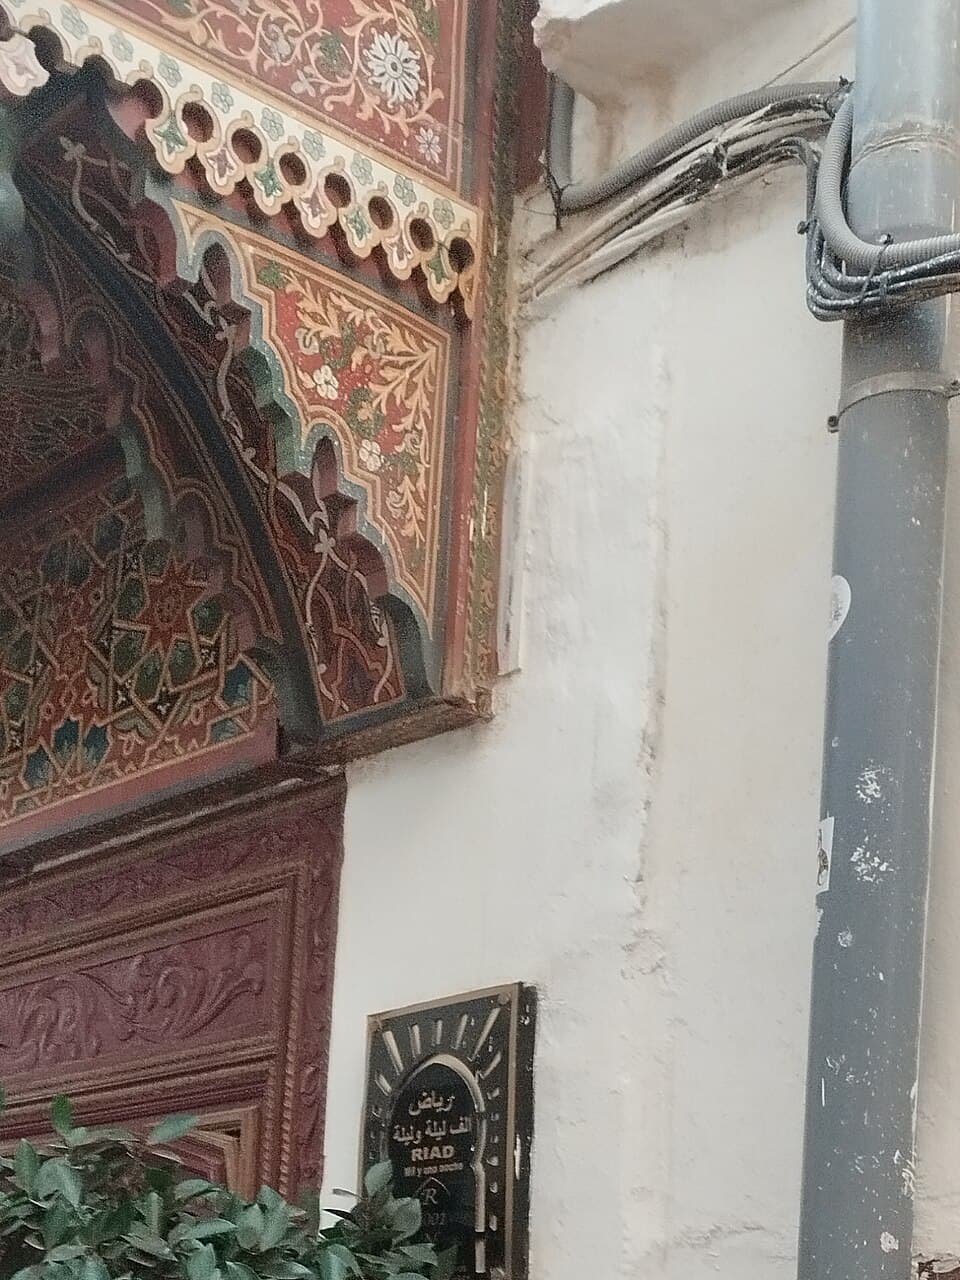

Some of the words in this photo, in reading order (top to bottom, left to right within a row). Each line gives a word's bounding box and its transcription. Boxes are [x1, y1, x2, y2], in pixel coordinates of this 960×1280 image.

[408, 1090, 456, 1116] رياض
[425, 1119, 447, 1141] ليلة
[411, 1144, 455, 1162] RIAD
